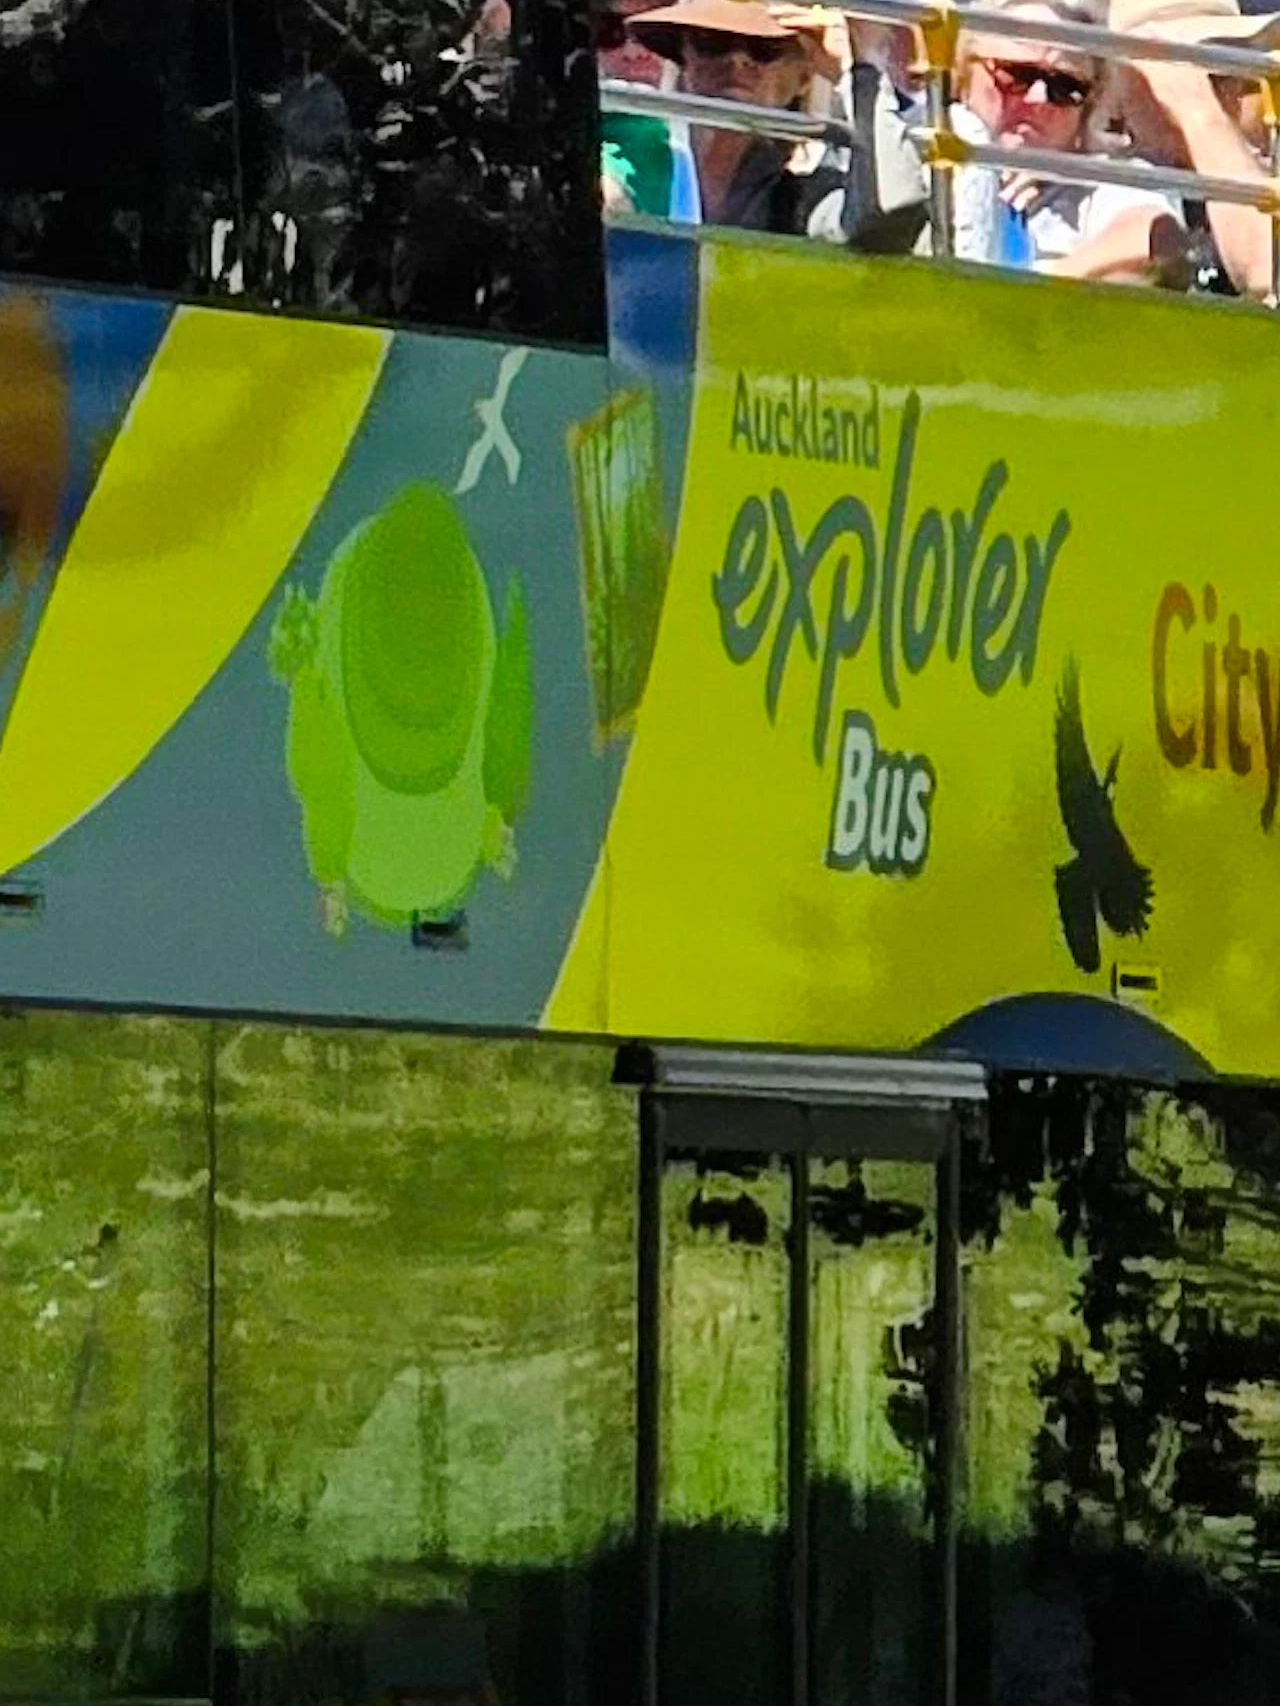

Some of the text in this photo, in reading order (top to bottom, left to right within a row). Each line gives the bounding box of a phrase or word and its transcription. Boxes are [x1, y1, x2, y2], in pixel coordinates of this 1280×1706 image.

[729, 370, 881, 469] Auckland
[711, 389, 1070, 768] explorer
[827, 711, 934, 875] Bus
[1152, 581, 1280, 836] City
